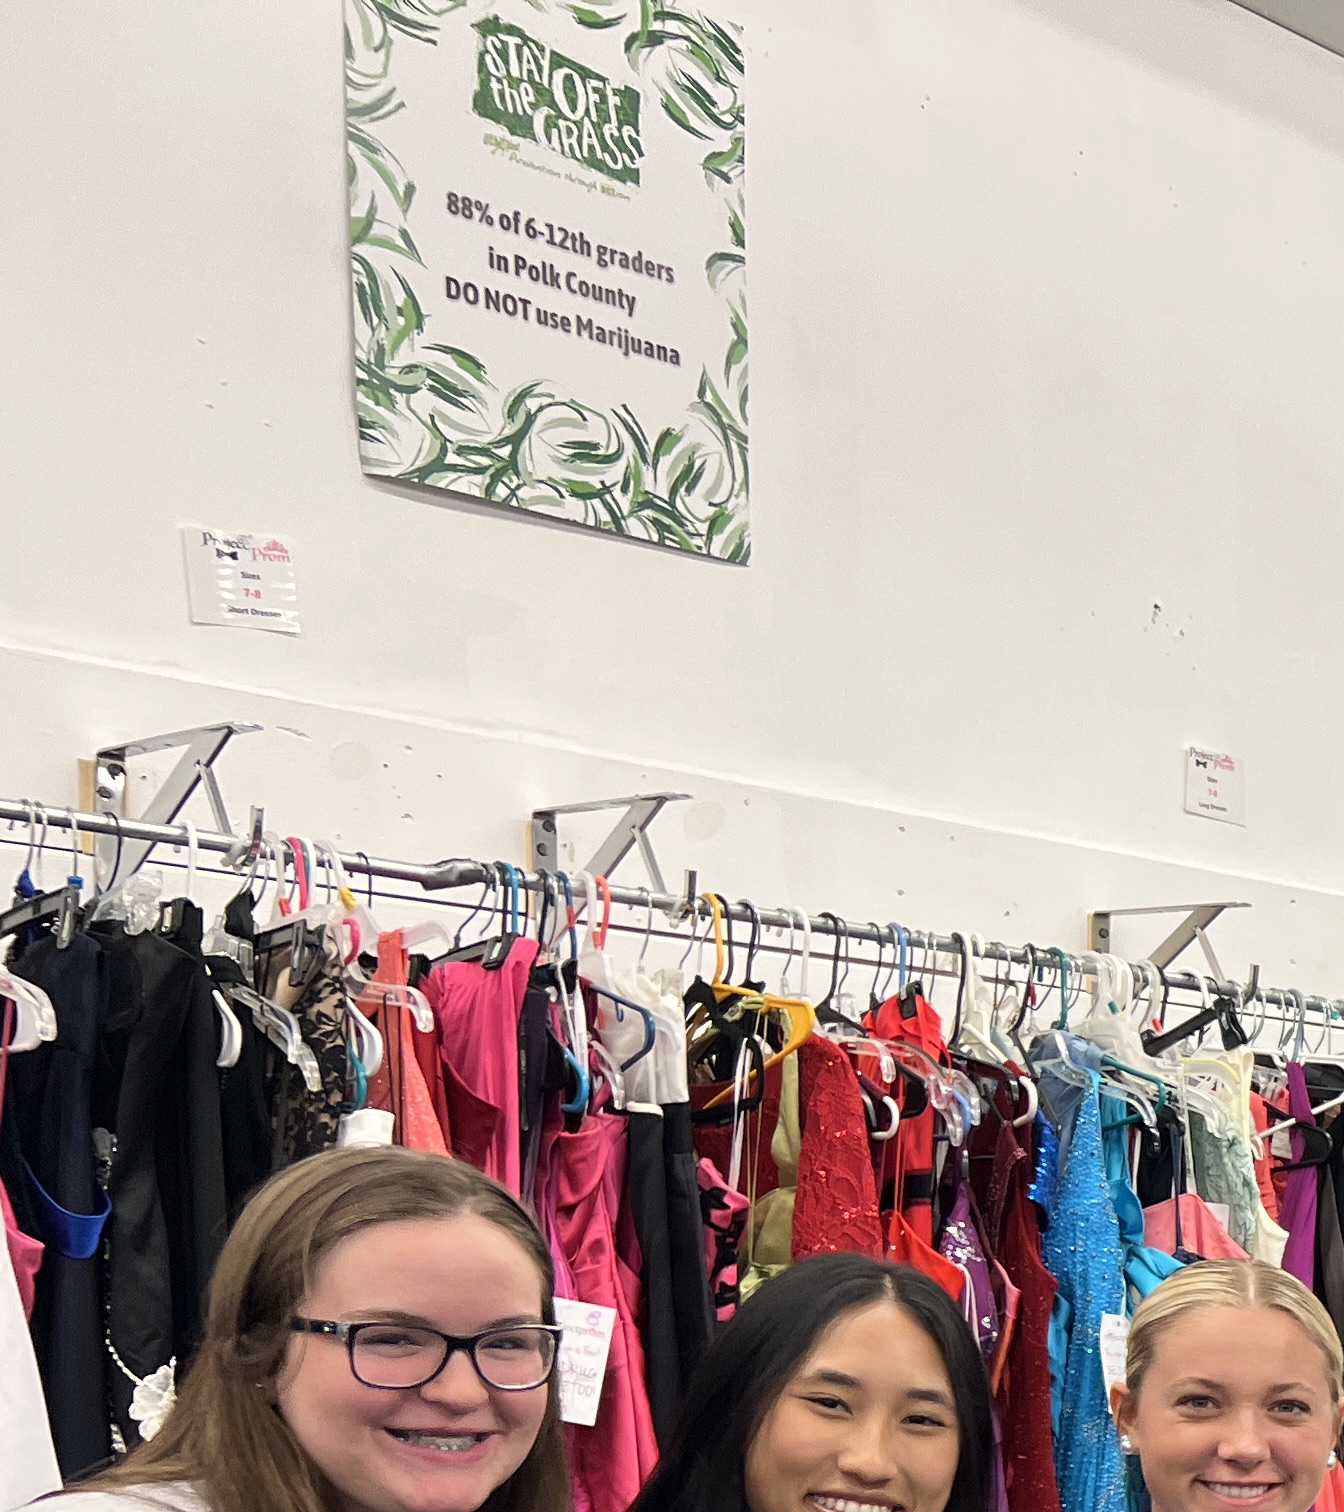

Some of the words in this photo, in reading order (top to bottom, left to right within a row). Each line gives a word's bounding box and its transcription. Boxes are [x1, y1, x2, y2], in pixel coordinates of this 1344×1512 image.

[484, 33, 550, 88] STAY
[552, 67, 621, 128] OFF
[489, 76, 536, 117] the
[532, 106, 645, 170] GRASS
[446, 191, 494, 226] 88%
[499, 210, 520, 235] of
[525, 217, 592, 257] 6-12th
[596, 244, 675, 283] graders
[489, 246, 508, 274] in
[514, 254, 562, 290] Polk
[566, 271, 636, 317] County
[445, 276, 479, 305] DO
[484, 287, 531, 321] NOT
[536, 307, 571, 333] use
[576, 314, 681, 366] Marijuana
